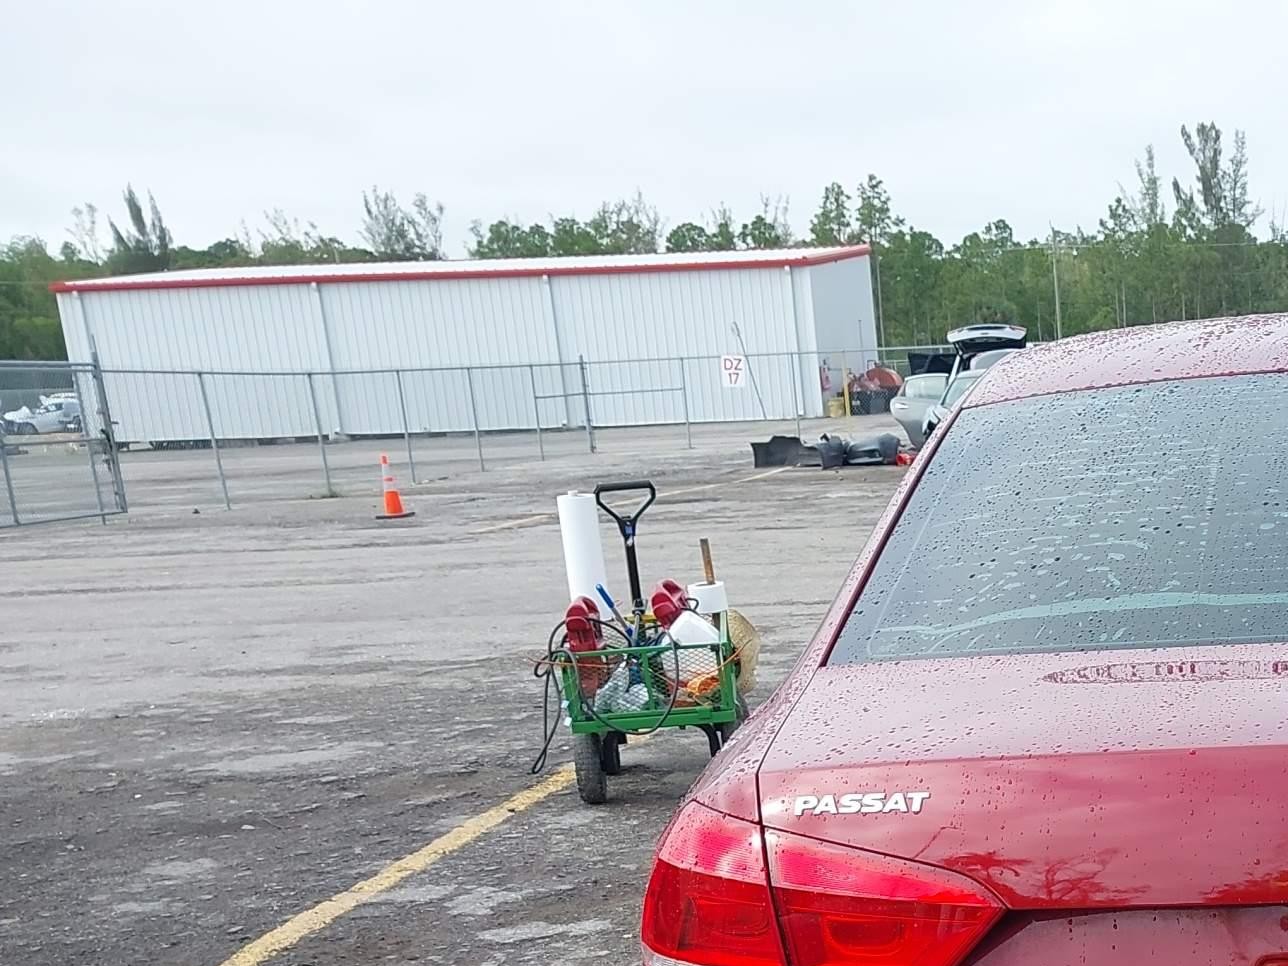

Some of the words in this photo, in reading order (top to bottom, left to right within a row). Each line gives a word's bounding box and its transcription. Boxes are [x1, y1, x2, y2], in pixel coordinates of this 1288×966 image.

[723, 358, 742, 371] DZ
[728, 372, 740, 385] 17
[794, 791, 931, 817] PASSAT
